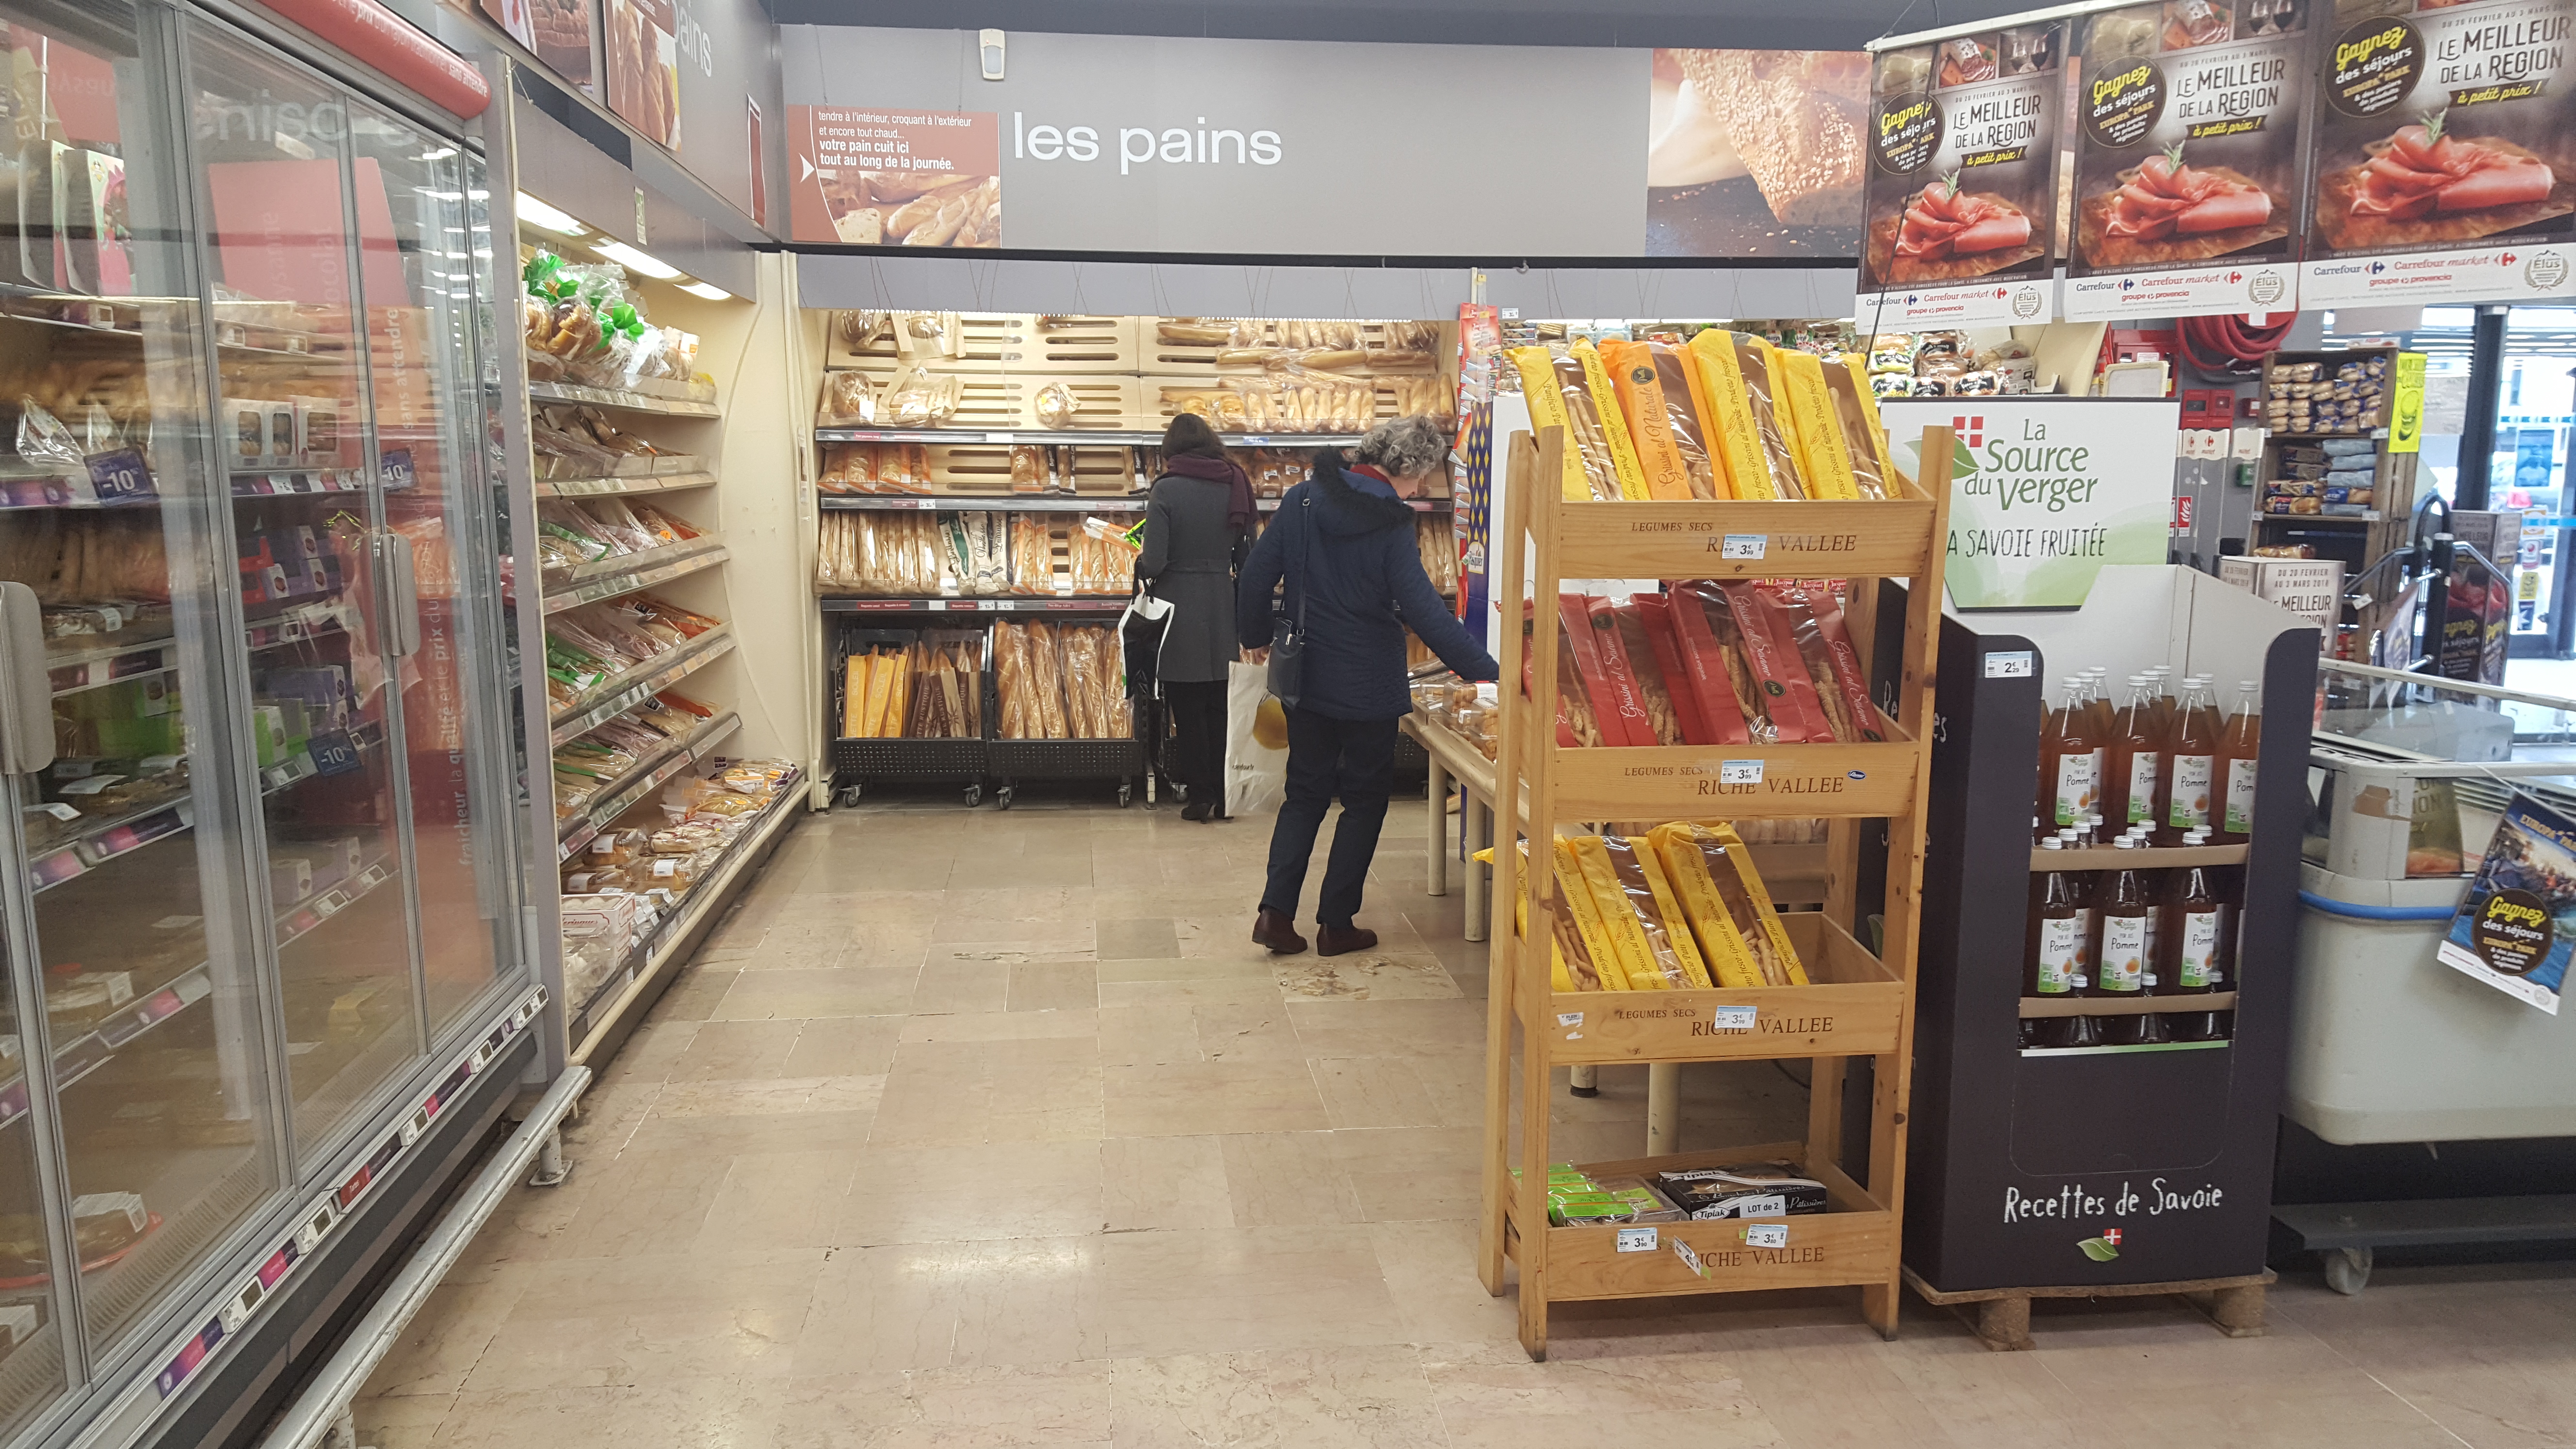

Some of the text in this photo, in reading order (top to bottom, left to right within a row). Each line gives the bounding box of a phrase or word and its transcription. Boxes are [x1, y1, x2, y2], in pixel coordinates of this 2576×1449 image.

[2336, 26, 2407, 71] Gagnez
[2437, 16, 2571, 62] LE MEILLEUR
[2335, 47, 2413, 85] des séjours
[2441, 46, 2563, 84] DE LA REGION
[2093, 65, 2151, 105] Gagnez
[2176, 60, 2285, 97] LE MEILLEUR
[1973, 92, 1996, 100] FEVRIER
[2093, 84, 2156, 117] des séjours
[2179, 86, 2279, 118] DE LA REGION
[2457, 84, 2531, 106] à petit prix
[819, 111, 971, 127] tendre à l'intérieur, croquant à l'extérieur
[1953, 95, 2041, 129] LE MEILLEUR
[819, 127, 904, 139] et encore tout chaud...
[1955, 119, 2037, 149] DE LA REGION
[2193, 120, 2254, 138] à petit prix
[820, 139, 909, 153] votre pain cuit ici
[1014, 111, 1283, 175] les pains
[1881, 134, 1899, 147] des
[1886, 142, 1914, 159] EUROPA
[1900, 151, 1910, 160] des
[1967, 151, 2016, 167] à petit prix
[820, 153, 954, 170] tout au long de la journée.
[2314, 256, 2489, 276] Carrefour Carrefour market
[2534, 257, 2560, 269] Élus
[2077, 274, 2219, 292] Carrefour Carrefour market
[2256, 274, 2278, 287] Élus
[2369, 274, 2452, 287] groupe provencia
[1924, 290, 1989, 302] Carrefour market
[2018, 291, 2036, 301] Élus
[2122, 290, 2190, 302] groupe provencia
[1907, 305, 1964, 316] groupe provencia
[387, 308, 408, 387] attendre
[399, 391, 415, 430] sans
[1639, 387, 1684, 487] Grissini al Naturale
[2023, 418, 2046, 441] La
[1985, 439, 2089, 473] Source
[1964, 472, 2099, 513] du Verger
[1631, 522, 1713, 531] LEGUMES SECS
[1778, 535, 1857, 552] VALLEE
[1966, 522, 2108, 557] SAVOIE FRUITÉE
[2282, 595, 2331, 612] MEILLEUR
[431, 627, 451, 661] prix
[1726, 595, 1771, 677] Grissini al Sesamo
[1603, 633, 1645, 718] Grissini al Sesamo
[1827, 639, 1869, 726] Grissini al Sesamo
[921, 685, 930, 721] RUSTIQUE
[1625, 766, 1703, 776] LEGUMES SECS
[1697, 777, 1844, 795] RICHE VALLEE
[2066, 775, 2090, 787] Pomme
[2181, 776, 2207, 788] Pomme
[1553, 845, 1618, 991] Prodotto fresco Grissini Prodotto fresco
[2487, 896, 2547, 928] Gagnez
[1694, 870, 1752, 979] fresco Grissini Prodotto
[2482, 919, 2544, 941] des séjours
[2049, 940, 2073, 952] Pomme
[2110, 937, 2139, 950] Pomme
[1632, 948, 1649, 974] Grissini
[1680, 944, 1706, 988] Panificio Patti
[1619, 1009, 1696, 1019] LEGUMES SECS
[1760, 1017, 1834, 1034] VALLEE
[1748, 1205, 1761, 1213] LOT
[1764, 1203, 1772, 1211] de
[2003, 1177, 2223, 1224] Recettes de Savoie
[1700, 1209, 1725, 1220] Tipiak
[1752, 1246, 1825, 1265] VALLEE
